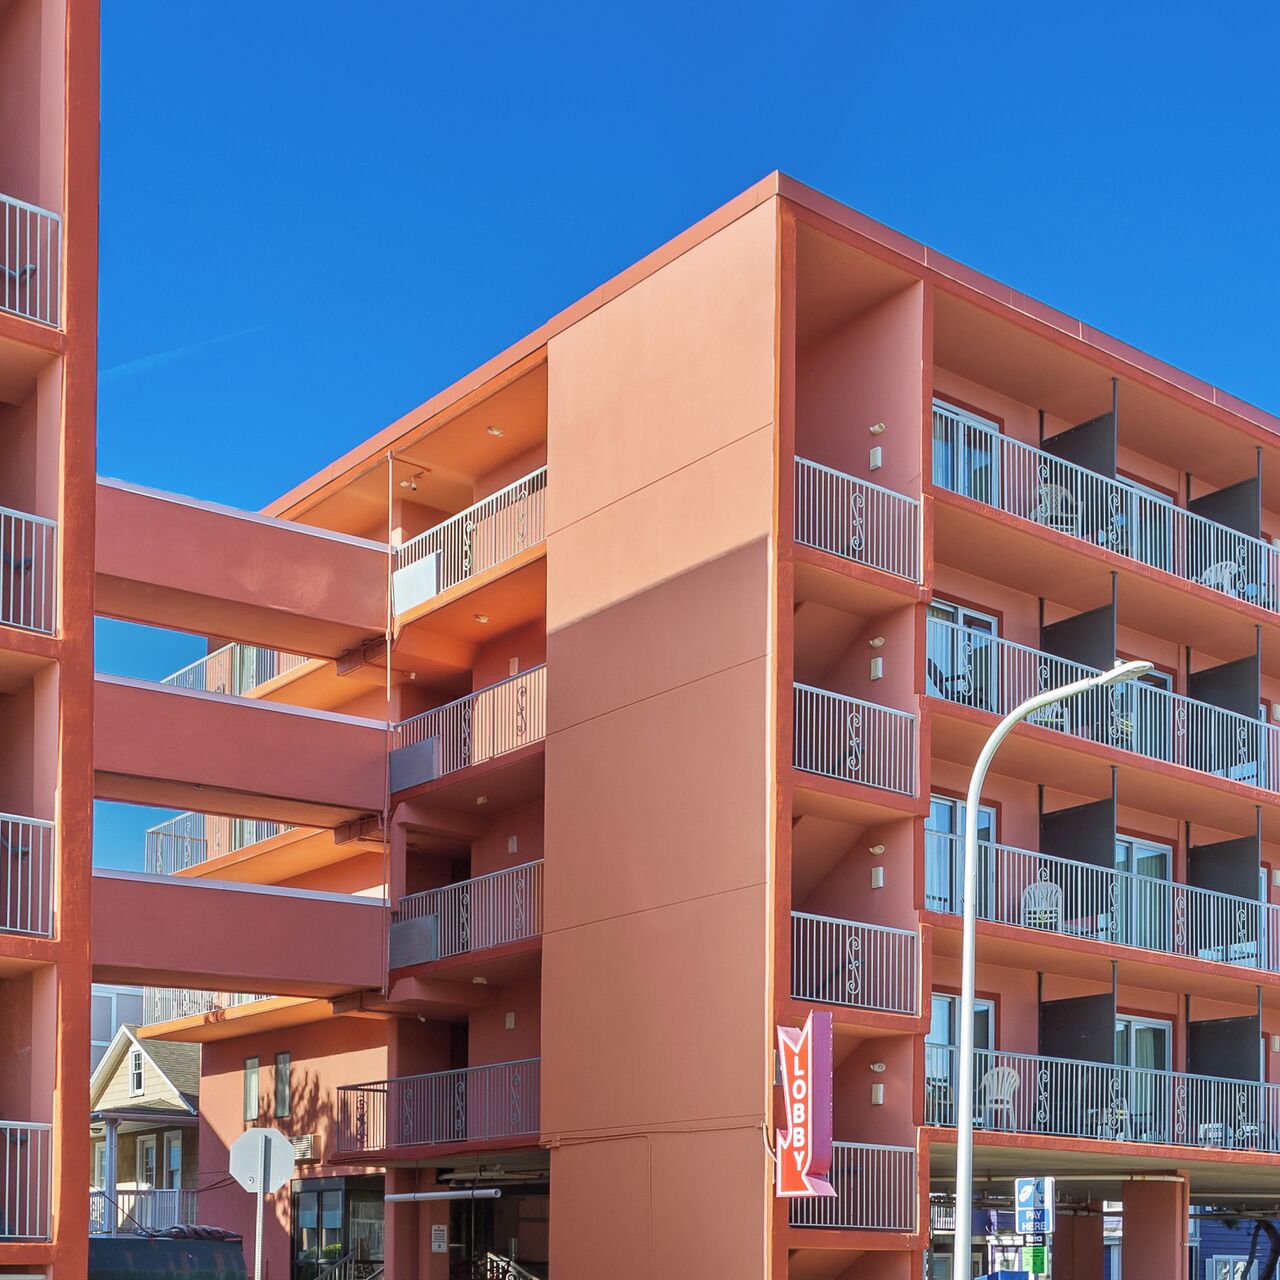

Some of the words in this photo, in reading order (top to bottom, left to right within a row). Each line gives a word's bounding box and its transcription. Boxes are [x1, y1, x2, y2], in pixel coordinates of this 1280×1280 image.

[792, 1055, 807, 1172] LOBBY
[1025, 1210, 1042, 1220] PAY
[1021, 1221, 1047, 1231] HERE
